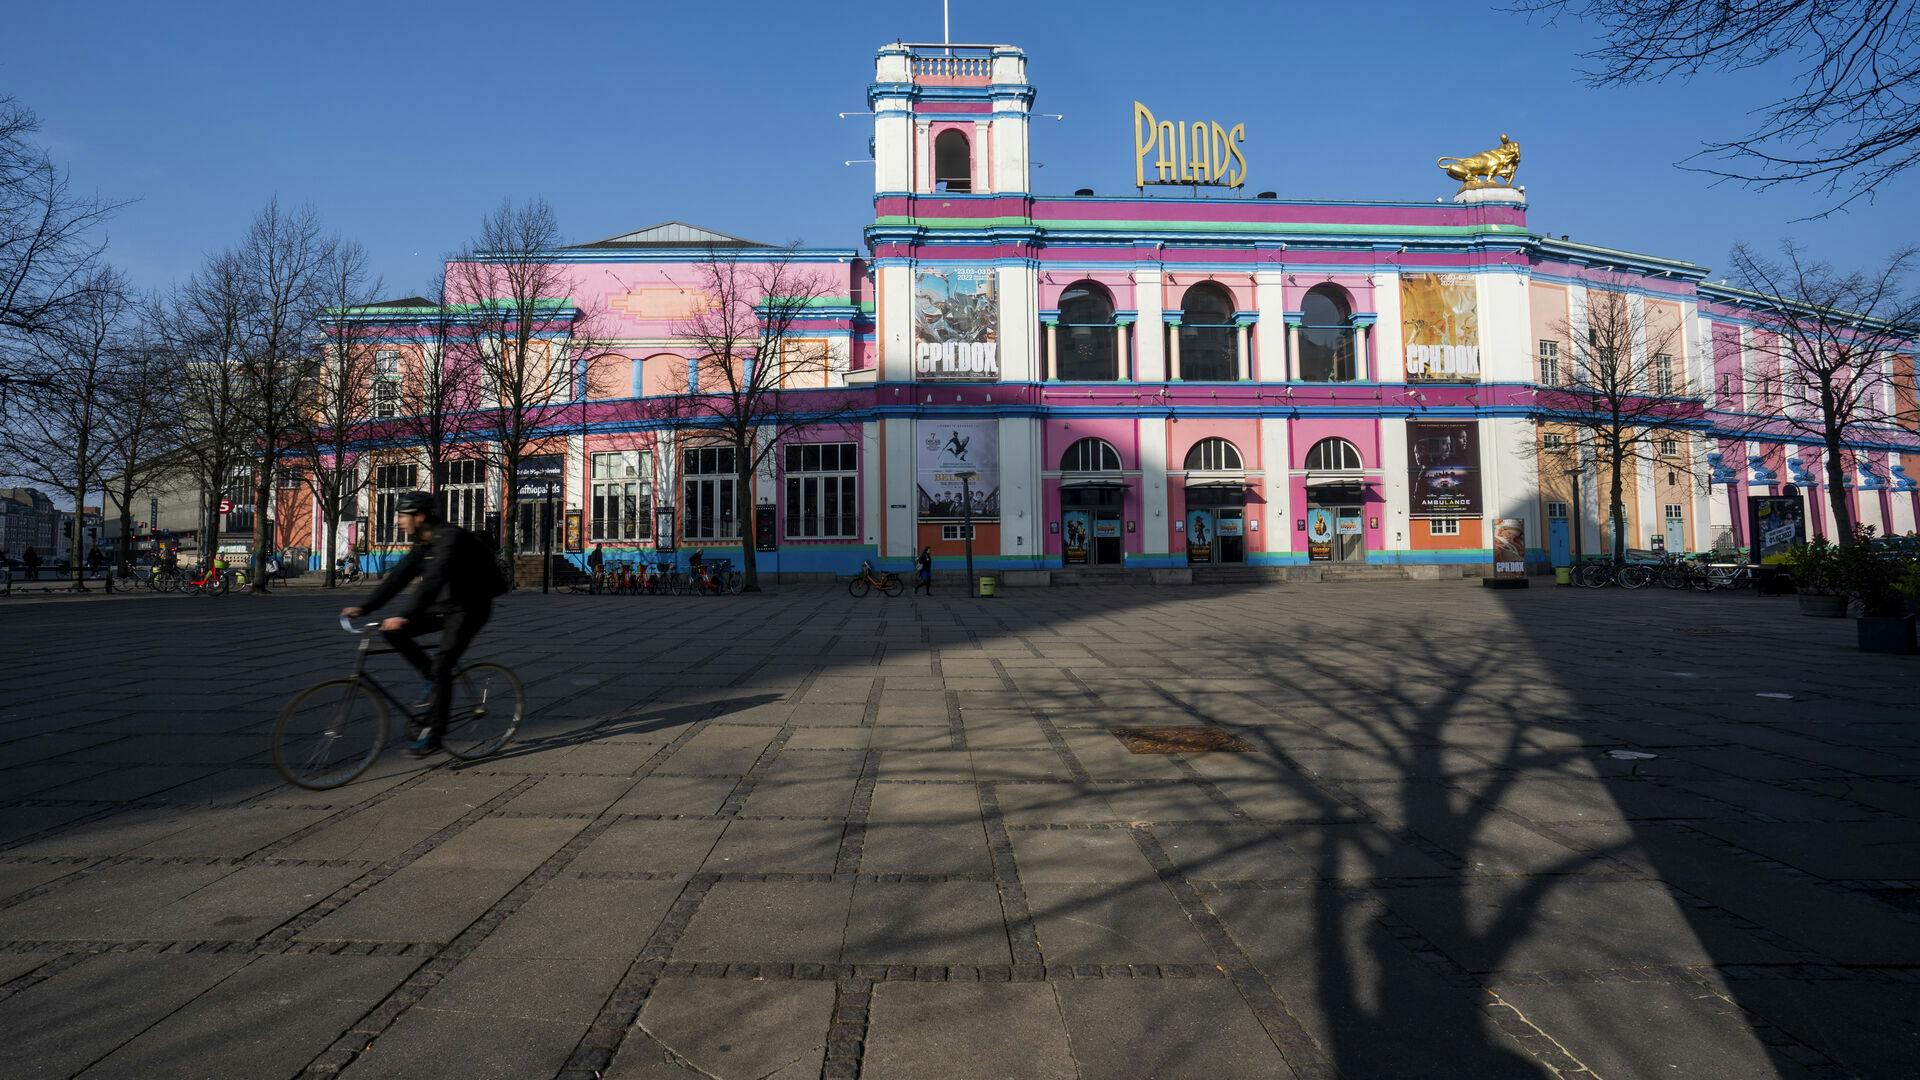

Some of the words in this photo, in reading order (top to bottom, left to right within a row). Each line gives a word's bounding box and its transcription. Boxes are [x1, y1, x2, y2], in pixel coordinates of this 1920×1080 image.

[1134, 100, 1247, 188] PALADS
[517, 484, 561, 496] nfbiopalds
[219, 501, 229, 512] S
